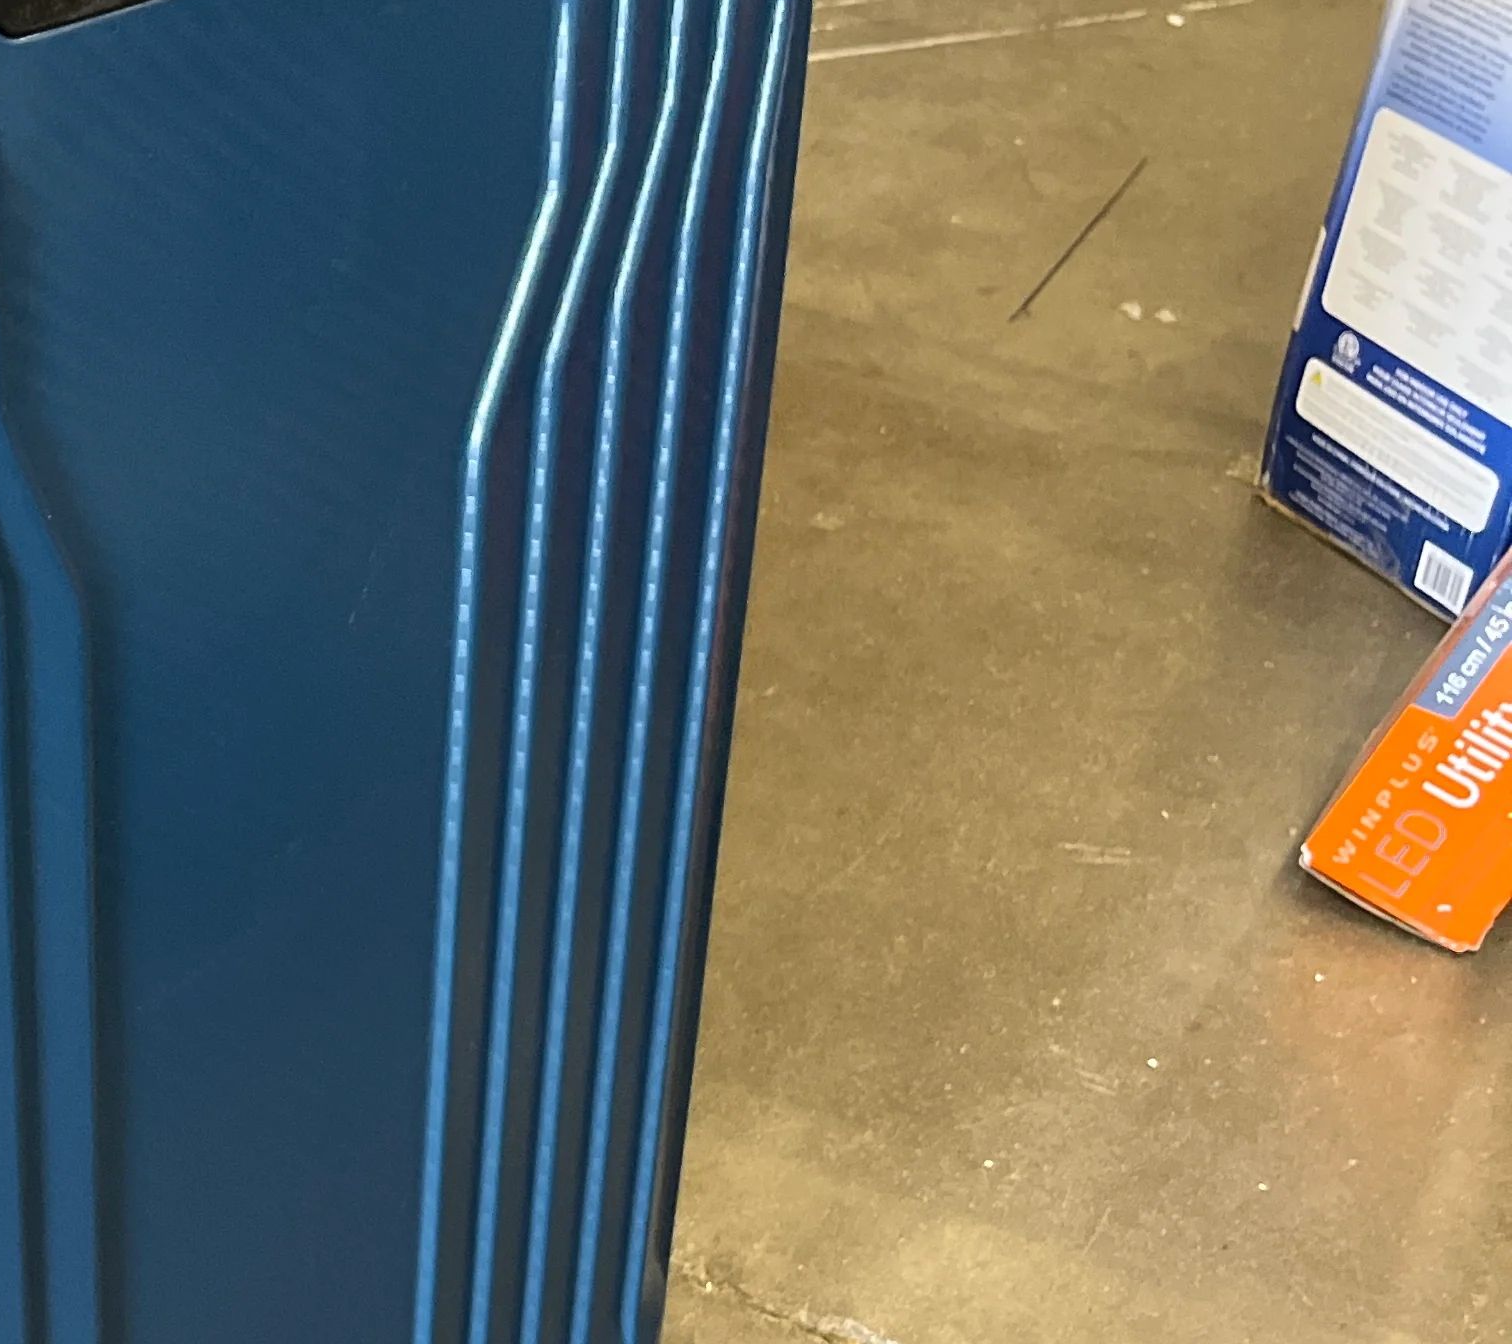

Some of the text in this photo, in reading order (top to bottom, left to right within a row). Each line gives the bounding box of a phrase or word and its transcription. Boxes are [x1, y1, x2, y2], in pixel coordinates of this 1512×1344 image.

[1461, 648, 1487, 677] cm
[1332, 728, 1439, 864] WINPLUS
[1358, 810, 1447, 898] LED
